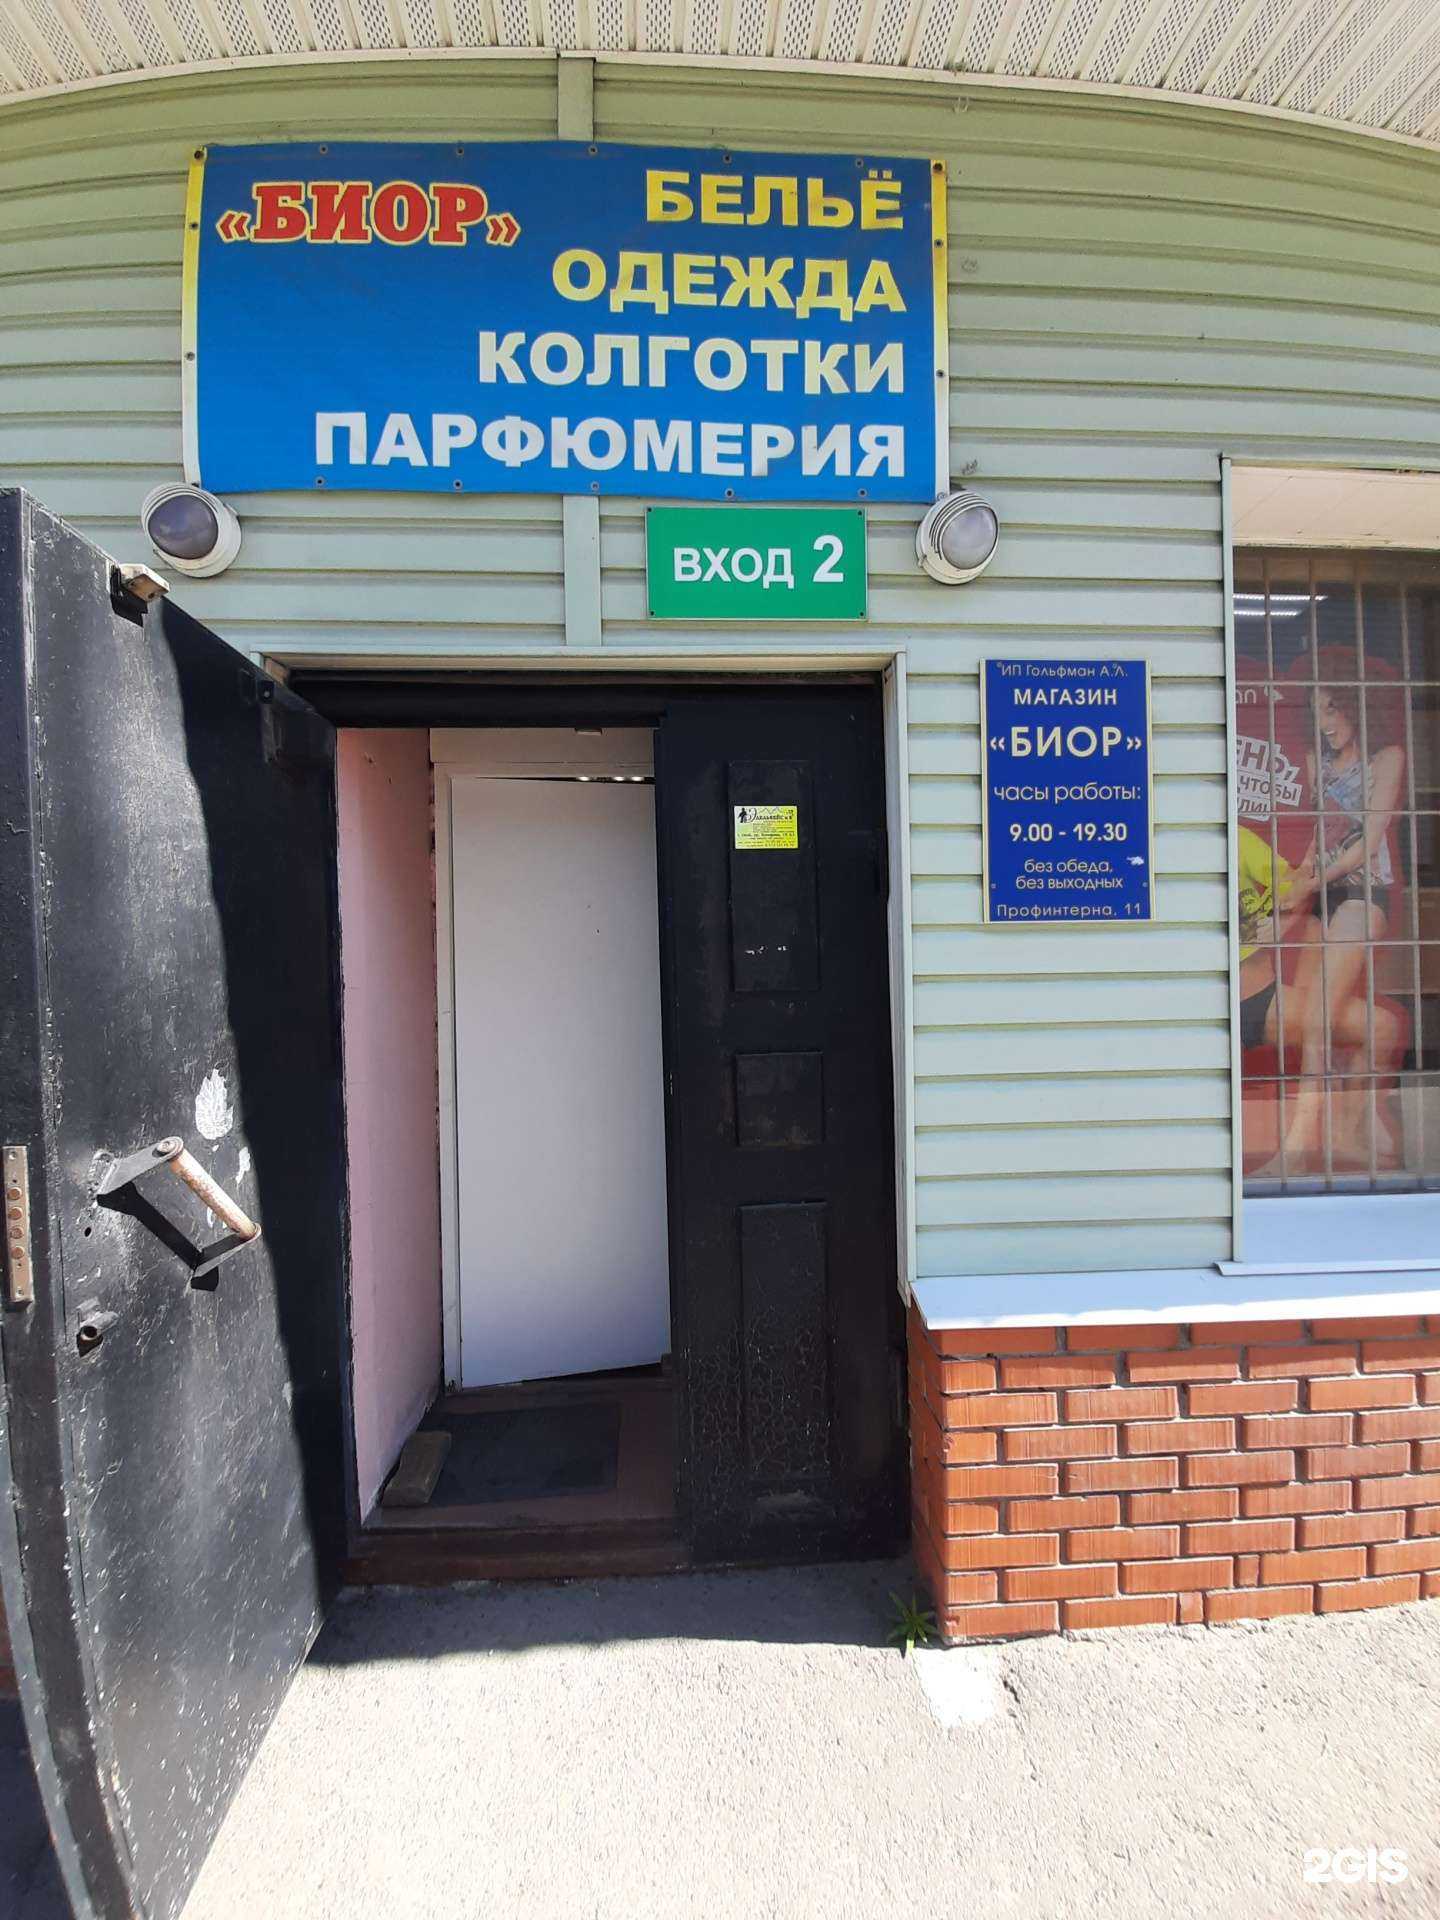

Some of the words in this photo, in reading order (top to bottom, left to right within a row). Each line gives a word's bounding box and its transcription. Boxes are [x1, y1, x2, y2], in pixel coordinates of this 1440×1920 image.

[646, 169, 904, 231] БЕЛЬЁ
[215, 181, 521, 247] «БИОР»
[552, 249, 907, 322] ОДЕЖДА
[478, 331, 905, 395] КОЛГОТКИ
[314, 410, 905, 479] ПАРФЮМЕРИЯ
[673, 546, 795, 589] ВХОД
[812, 534, 845, 584] 2
[1001, 664, 1022, 677] ИП
[1026, 664, 1096, 679] Гольфман
[1013, 688, 1118, 706] МАГАЗИН
[989, 725, 1142, 758] «БИОР»
[994, 784, 1049, 801] часы
[1054, 782, 1142, 804] работы:
[1009, 823, 1053, 842] 9.00
[1073, 823, 1128, 842] 19.30
[1024, 858, 1053, 873] без
[1015, 875, 1044, 890] без
[1048, 877, 1124, 891] выходных
[1124, 902, 1141, 916] 11
